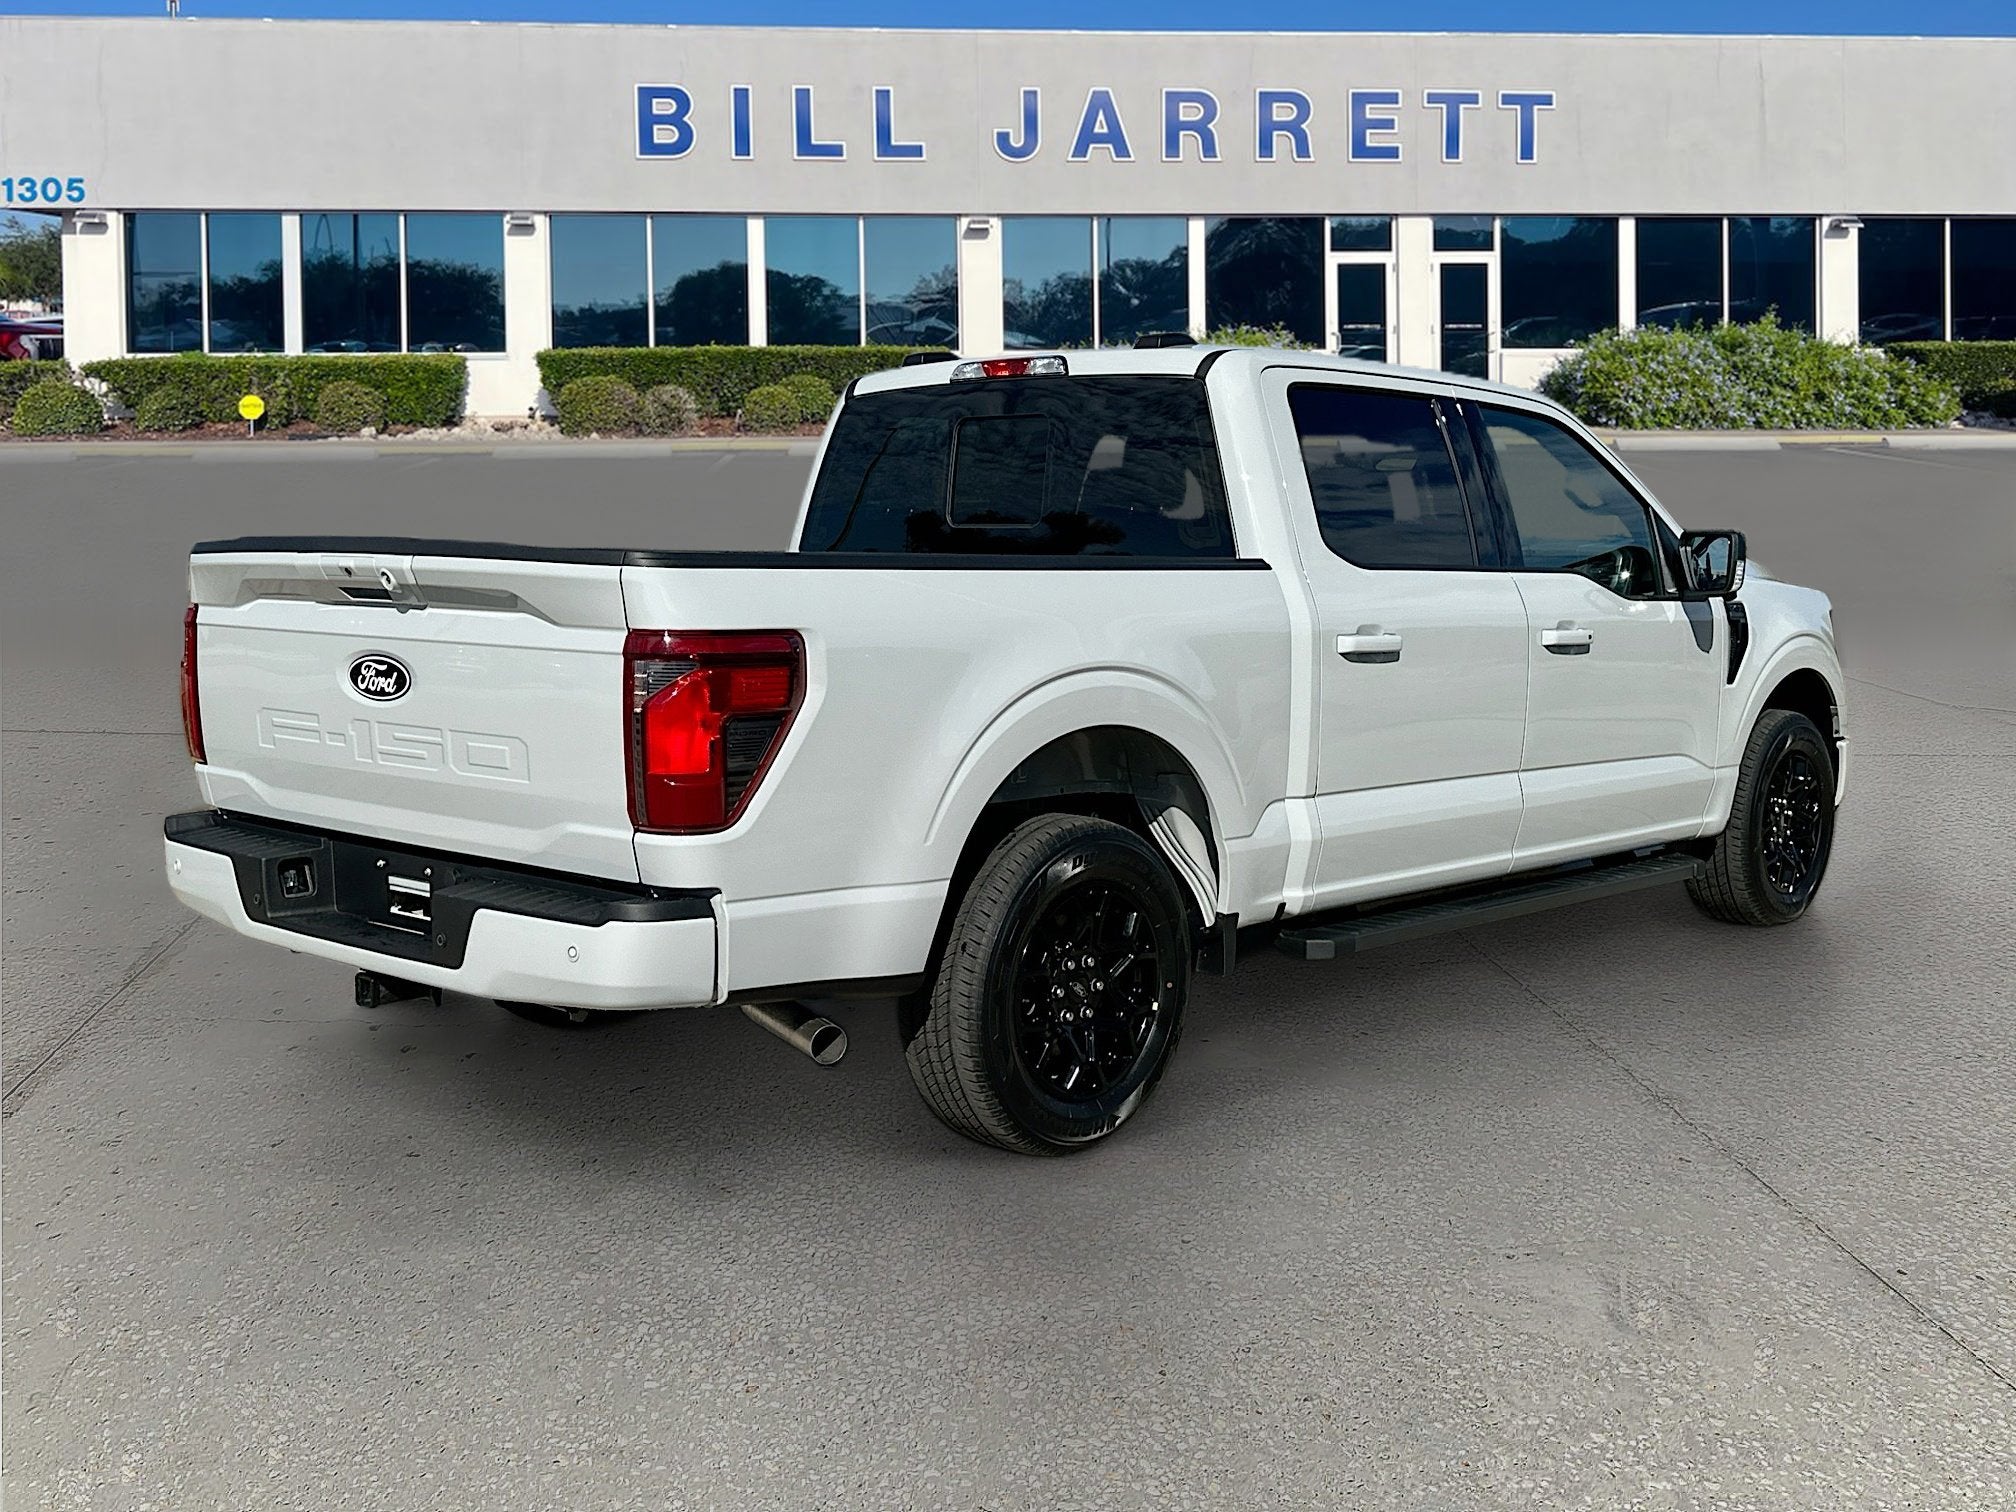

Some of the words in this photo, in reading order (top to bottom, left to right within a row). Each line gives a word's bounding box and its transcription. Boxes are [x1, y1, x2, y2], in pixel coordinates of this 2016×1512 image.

[635, 84, 926, 161] BILL
[993, 87, 1556, 164] JARRETT
[1, 176, 86, 203] 1305
[357, 661, 398, 694] Ford
[257, 707, 532, 784] F-150
